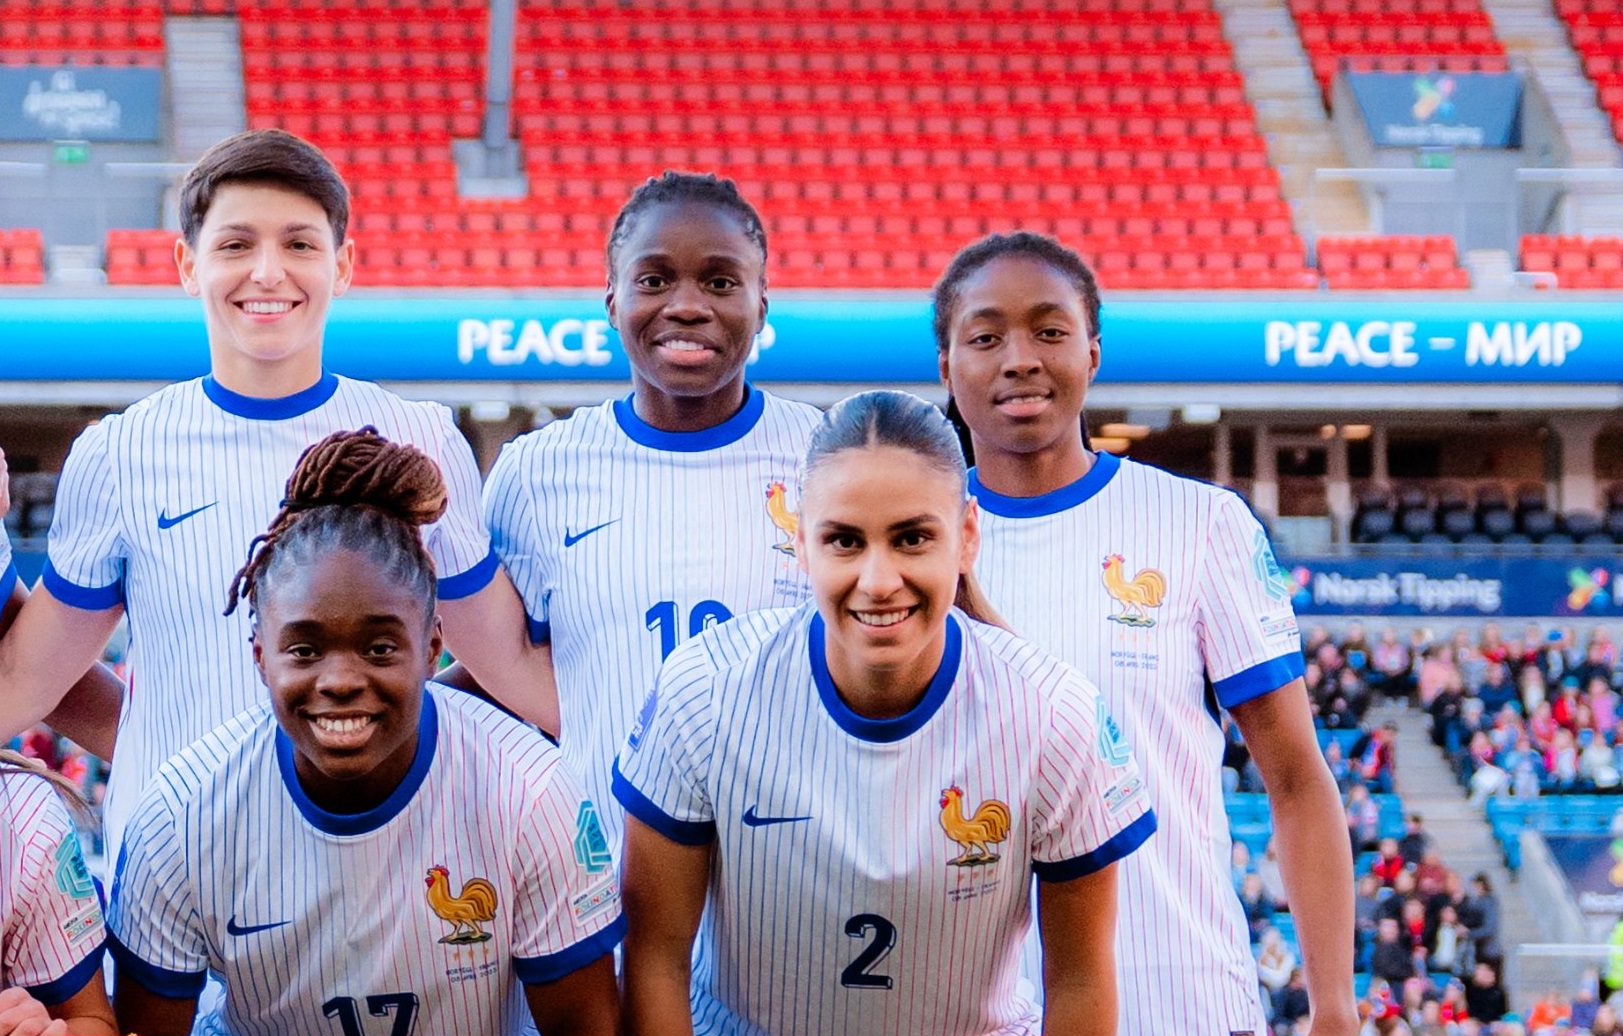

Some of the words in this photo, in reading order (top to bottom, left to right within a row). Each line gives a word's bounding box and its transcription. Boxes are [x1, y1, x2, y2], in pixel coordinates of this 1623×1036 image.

[457, 319, 613, 366] PEACE
[1264, 321, 1420, 367] PEACE
[1465, 321, 1583, 367] МИР
[1314, 572, 1399, 605] Norsk
[1398, 572, 1502, 613] Tipping
[840, 913, 898, 990] 2
